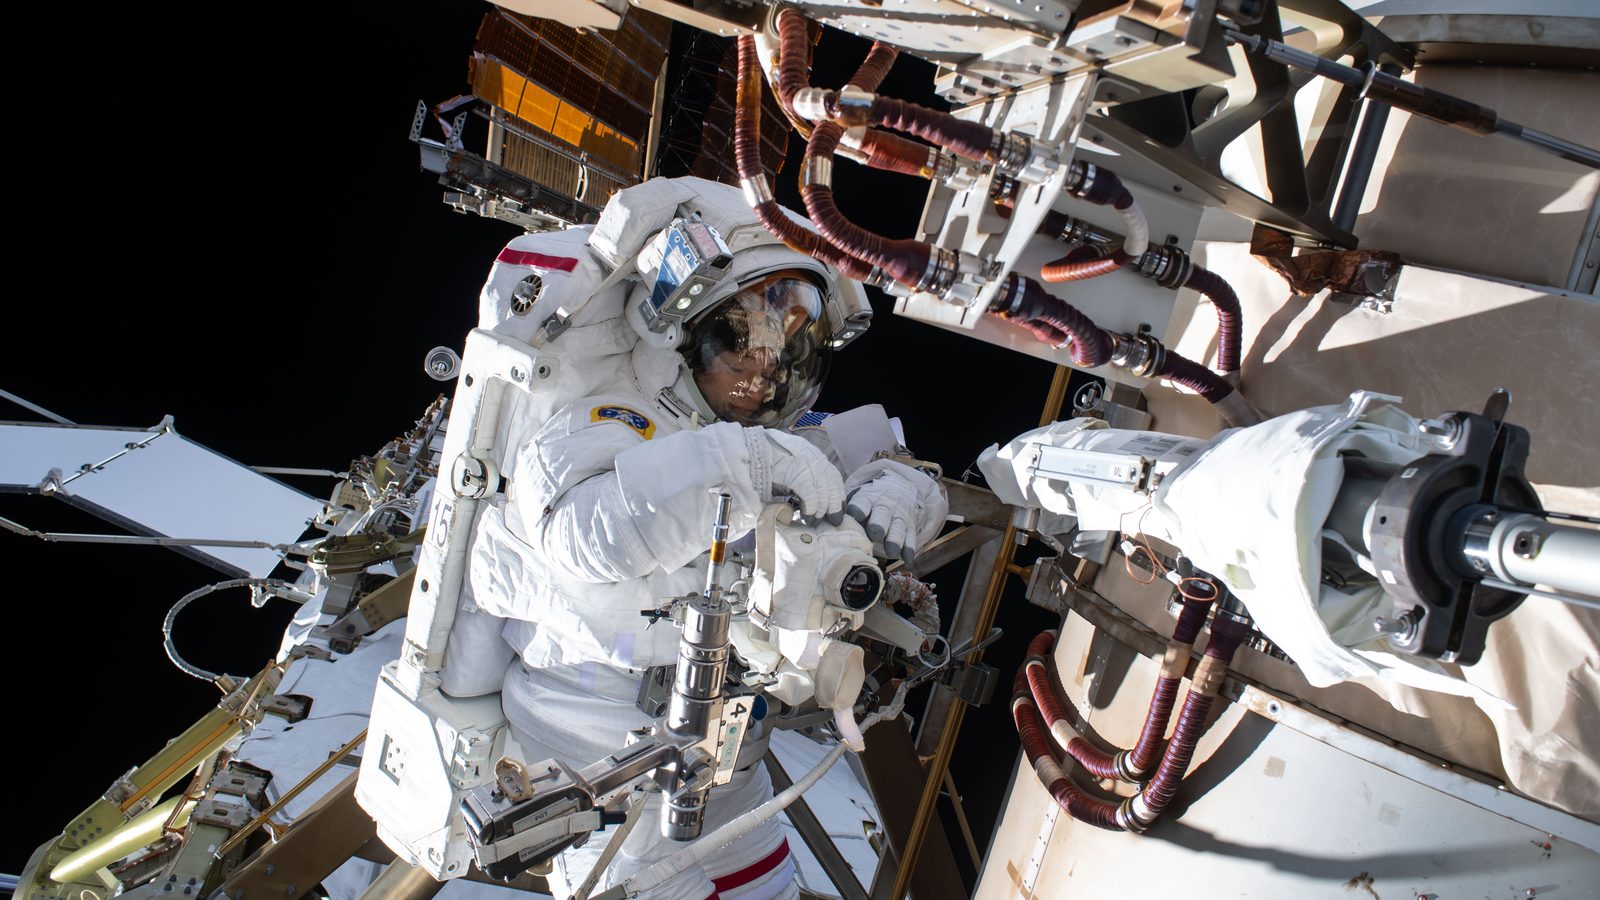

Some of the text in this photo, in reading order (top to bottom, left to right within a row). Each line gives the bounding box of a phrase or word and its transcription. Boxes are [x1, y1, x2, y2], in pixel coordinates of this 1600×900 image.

[431, 498, 452, 548] 15
[730, 702, 747, 718] 4
[534, 811, 548, 821] PGT
